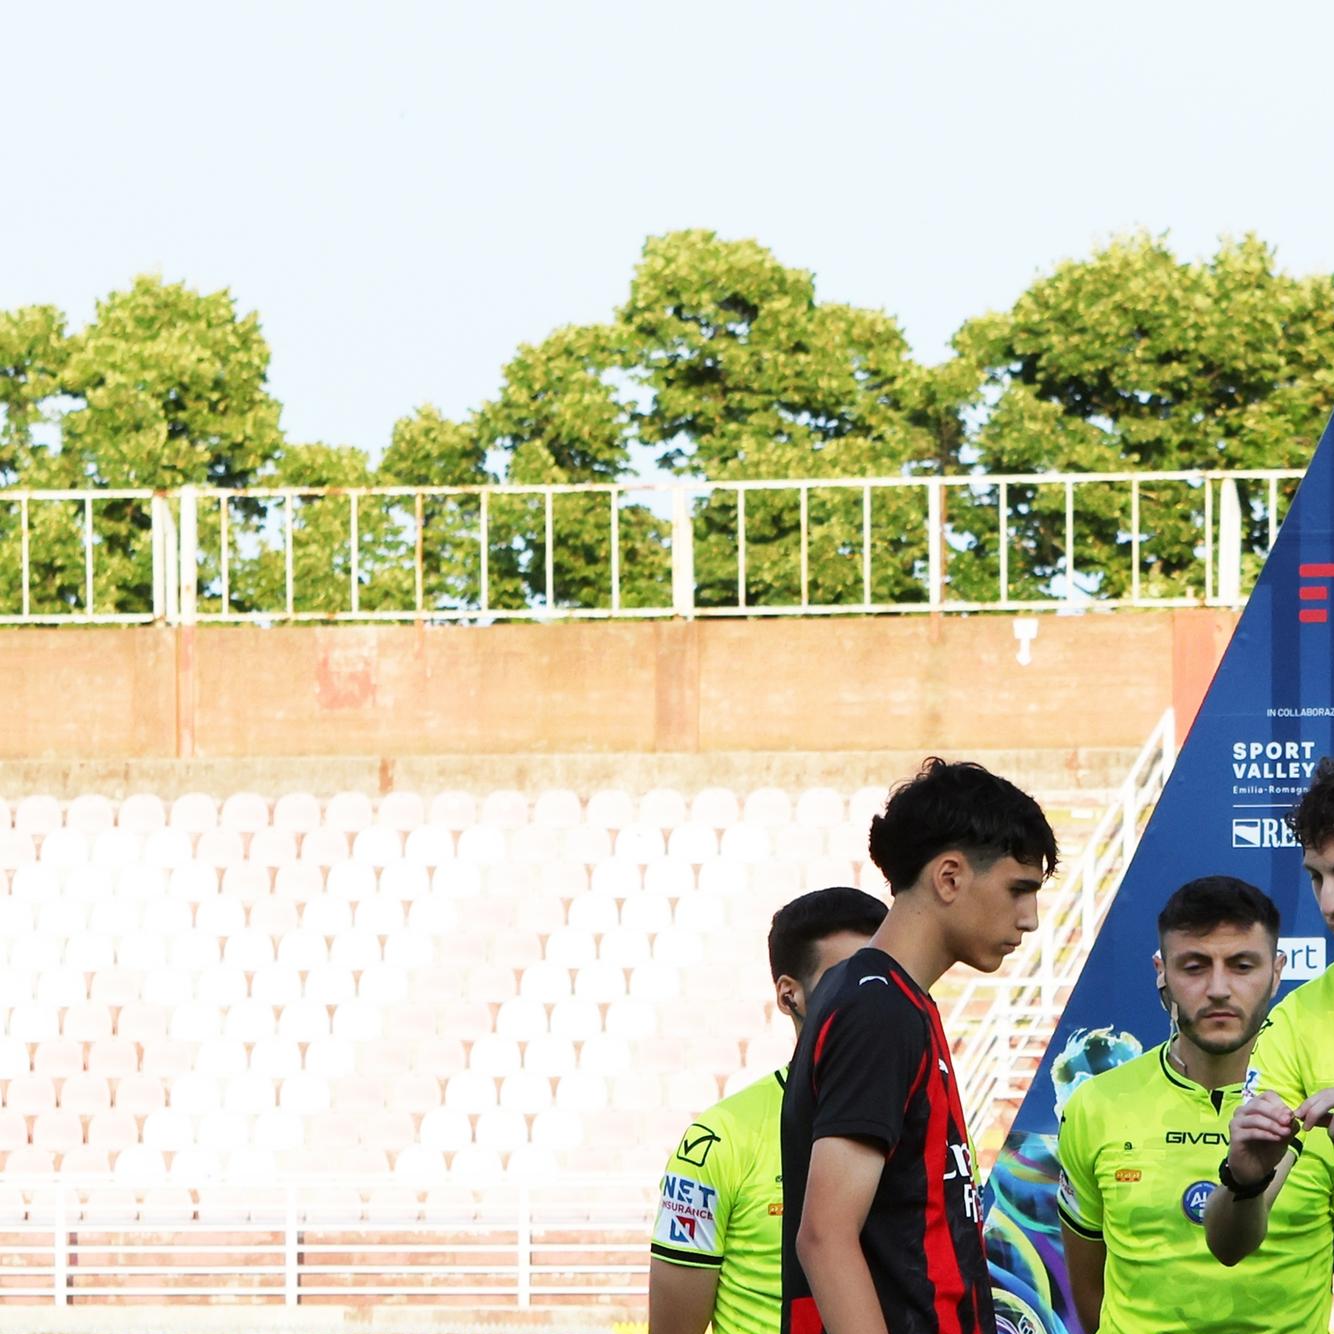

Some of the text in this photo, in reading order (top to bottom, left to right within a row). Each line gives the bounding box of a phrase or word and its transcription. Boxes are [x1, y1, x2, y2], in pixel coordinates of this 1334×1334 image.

[1266, 708, 1276, 717] IN
[1232, 741, 1316, 760] SPORT
[1232, 762, 1316, 779] VALLEY
[663, 1175, 716, 1209] NET
